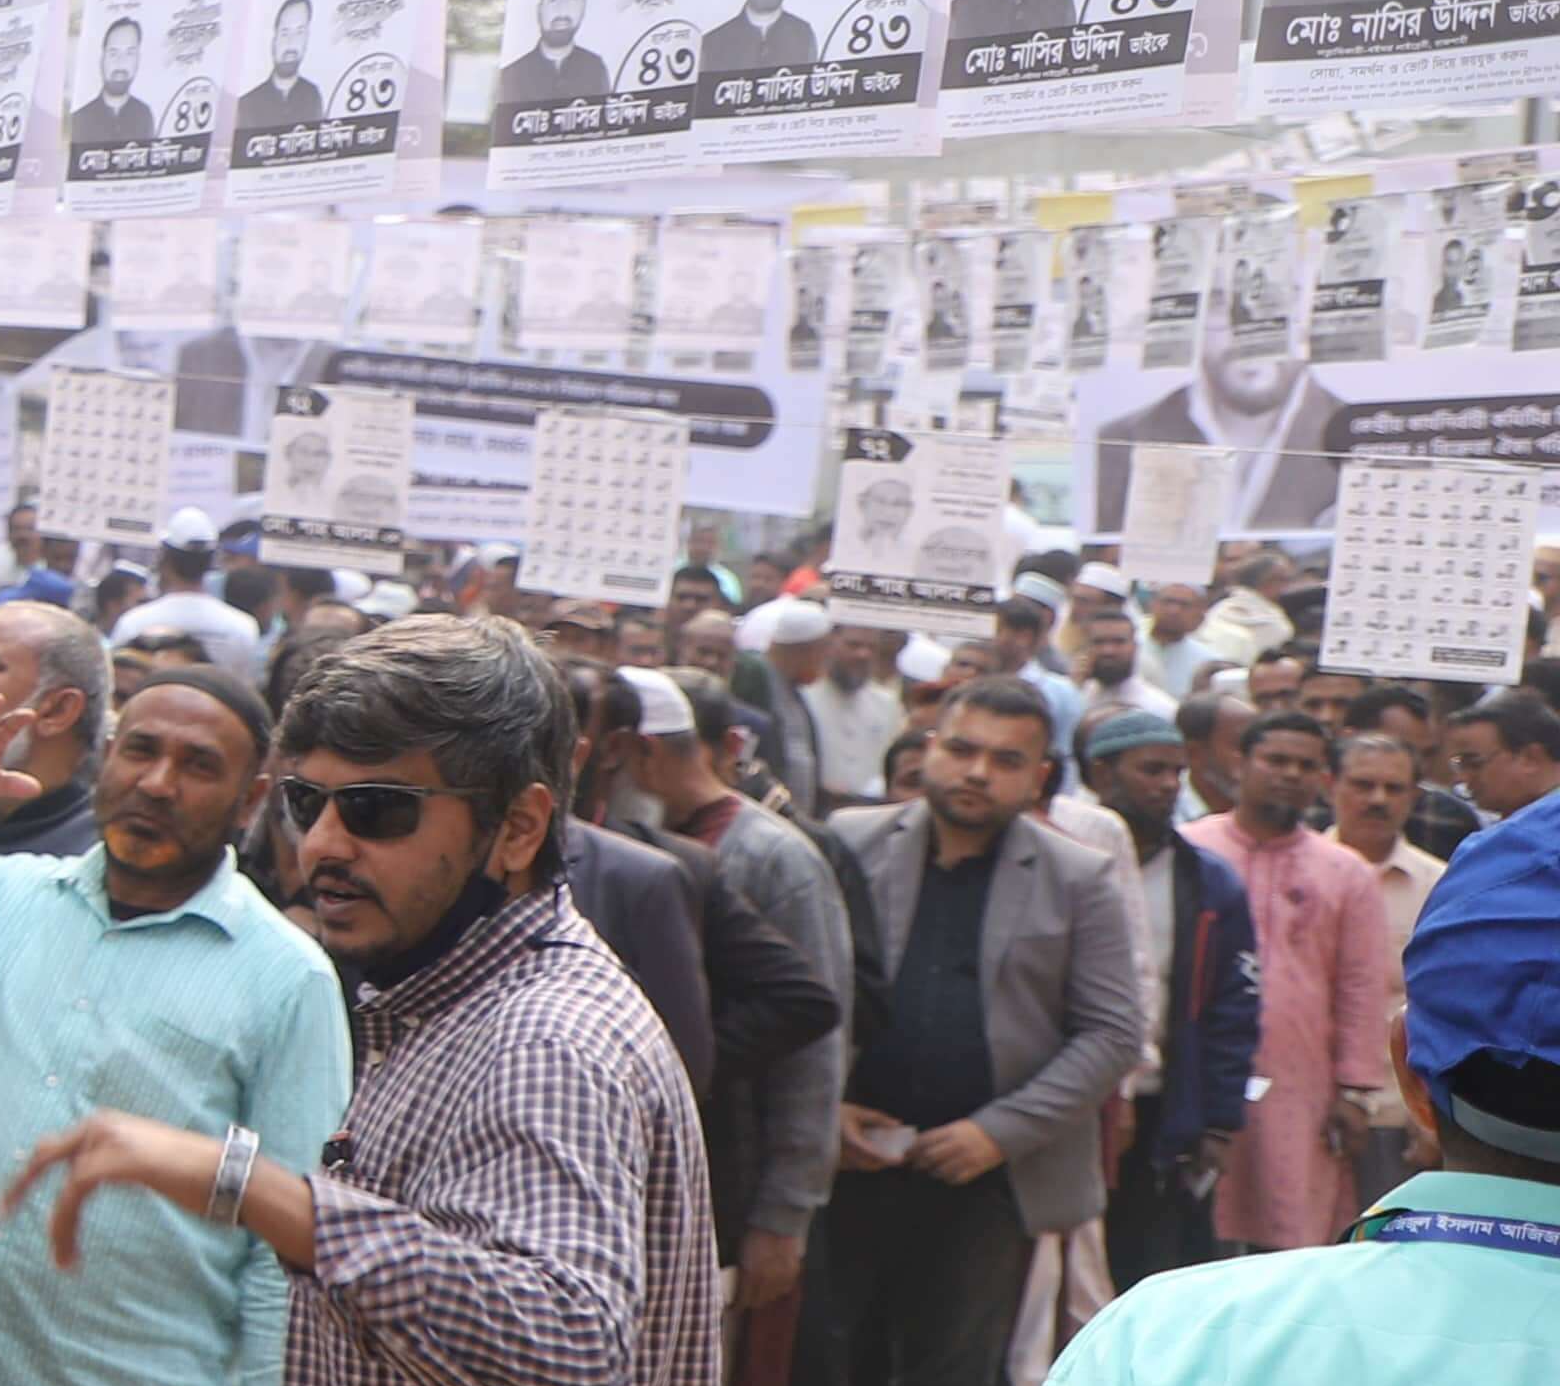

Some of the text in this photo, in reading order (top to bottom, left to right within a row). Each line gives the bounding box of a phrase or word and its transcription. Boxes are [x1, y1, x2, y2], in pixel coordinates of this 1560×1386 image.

[847, 12, 912, 55] ৪৩
[1286, 12, 1341, 45] মোঃ
[1351, 1, 1426, 41] নাসির
[1509, 0, 1560, 23] ভাইকে
[638, 46, 695, 87] ৪৩
[966, 26, 1170, 74] মোঃ নাসির উদ্দিন ভাইকে
[345, 75, 397, 112] ৪৩
[715, 62, 859, 106] মোঃ নাসির উদ্দিন
[512, 94, 651, 135] মোঃ নাসির উদ্দিন
